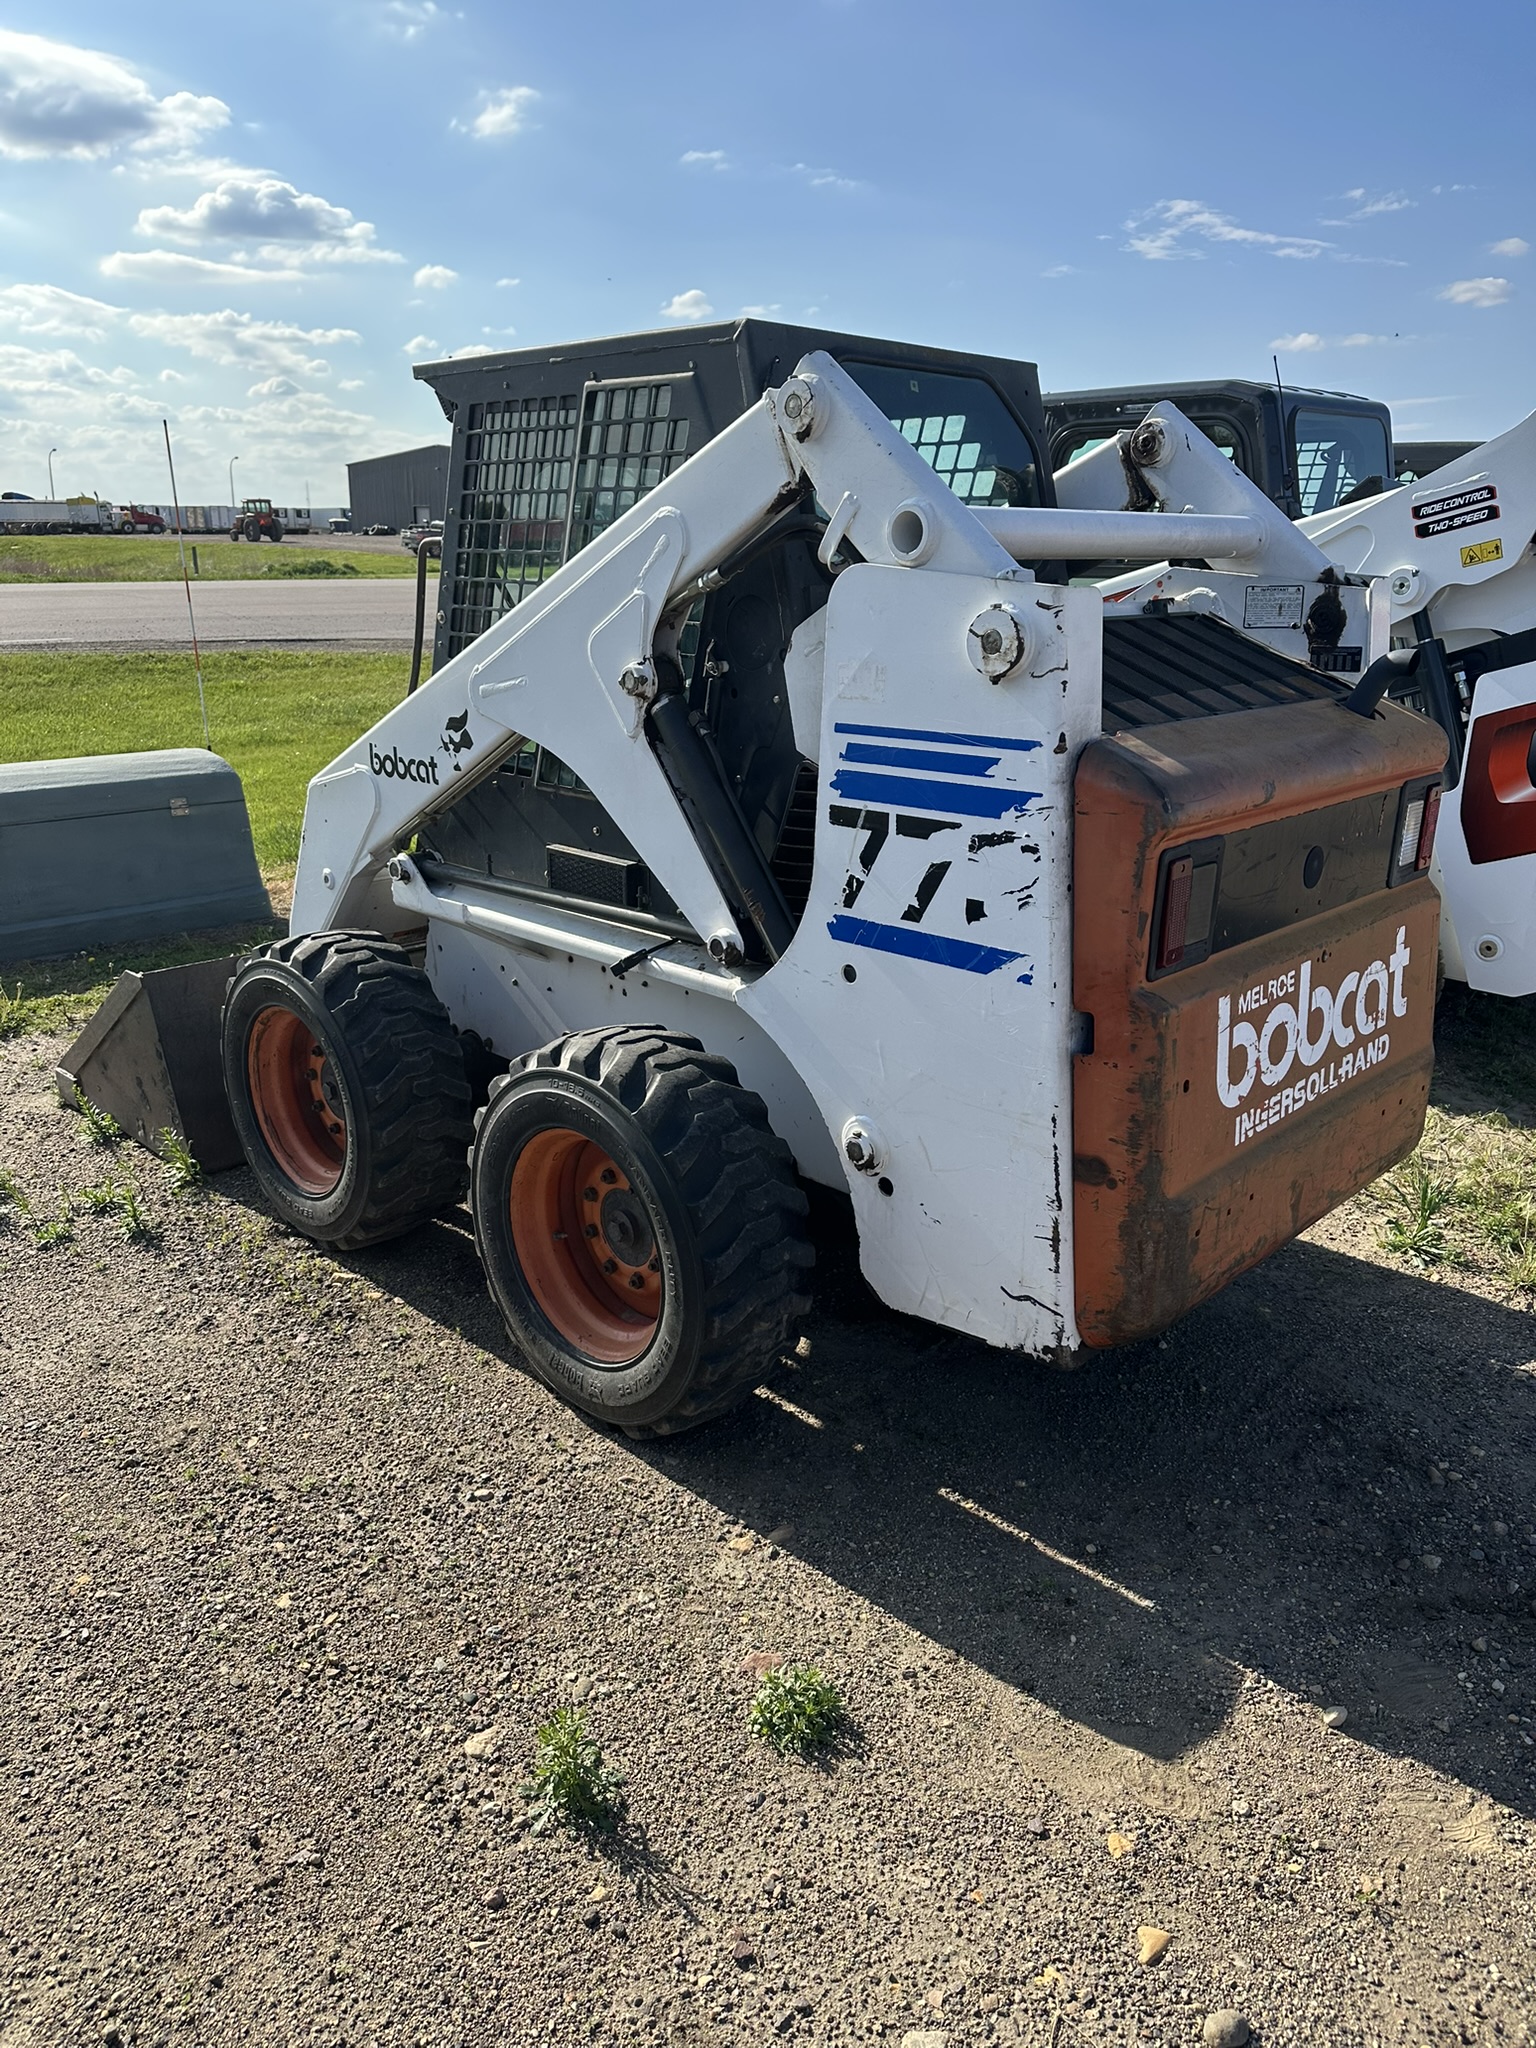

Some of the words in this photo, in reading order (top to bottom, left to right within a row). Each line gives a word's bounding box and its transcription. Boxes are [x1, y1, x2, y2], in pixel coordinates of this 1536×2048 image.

[1420, 501, 1444, 516] RIDE
[1443, 489, 1491, 510] CONTROL
[1428, 509, 1488, 533] TWO-SPEED
[368, 742, 440, 785] bobcat
[1238, 970, 1296, 1015] MELROE
[1216, 925, 1411, 1109] bobcat
